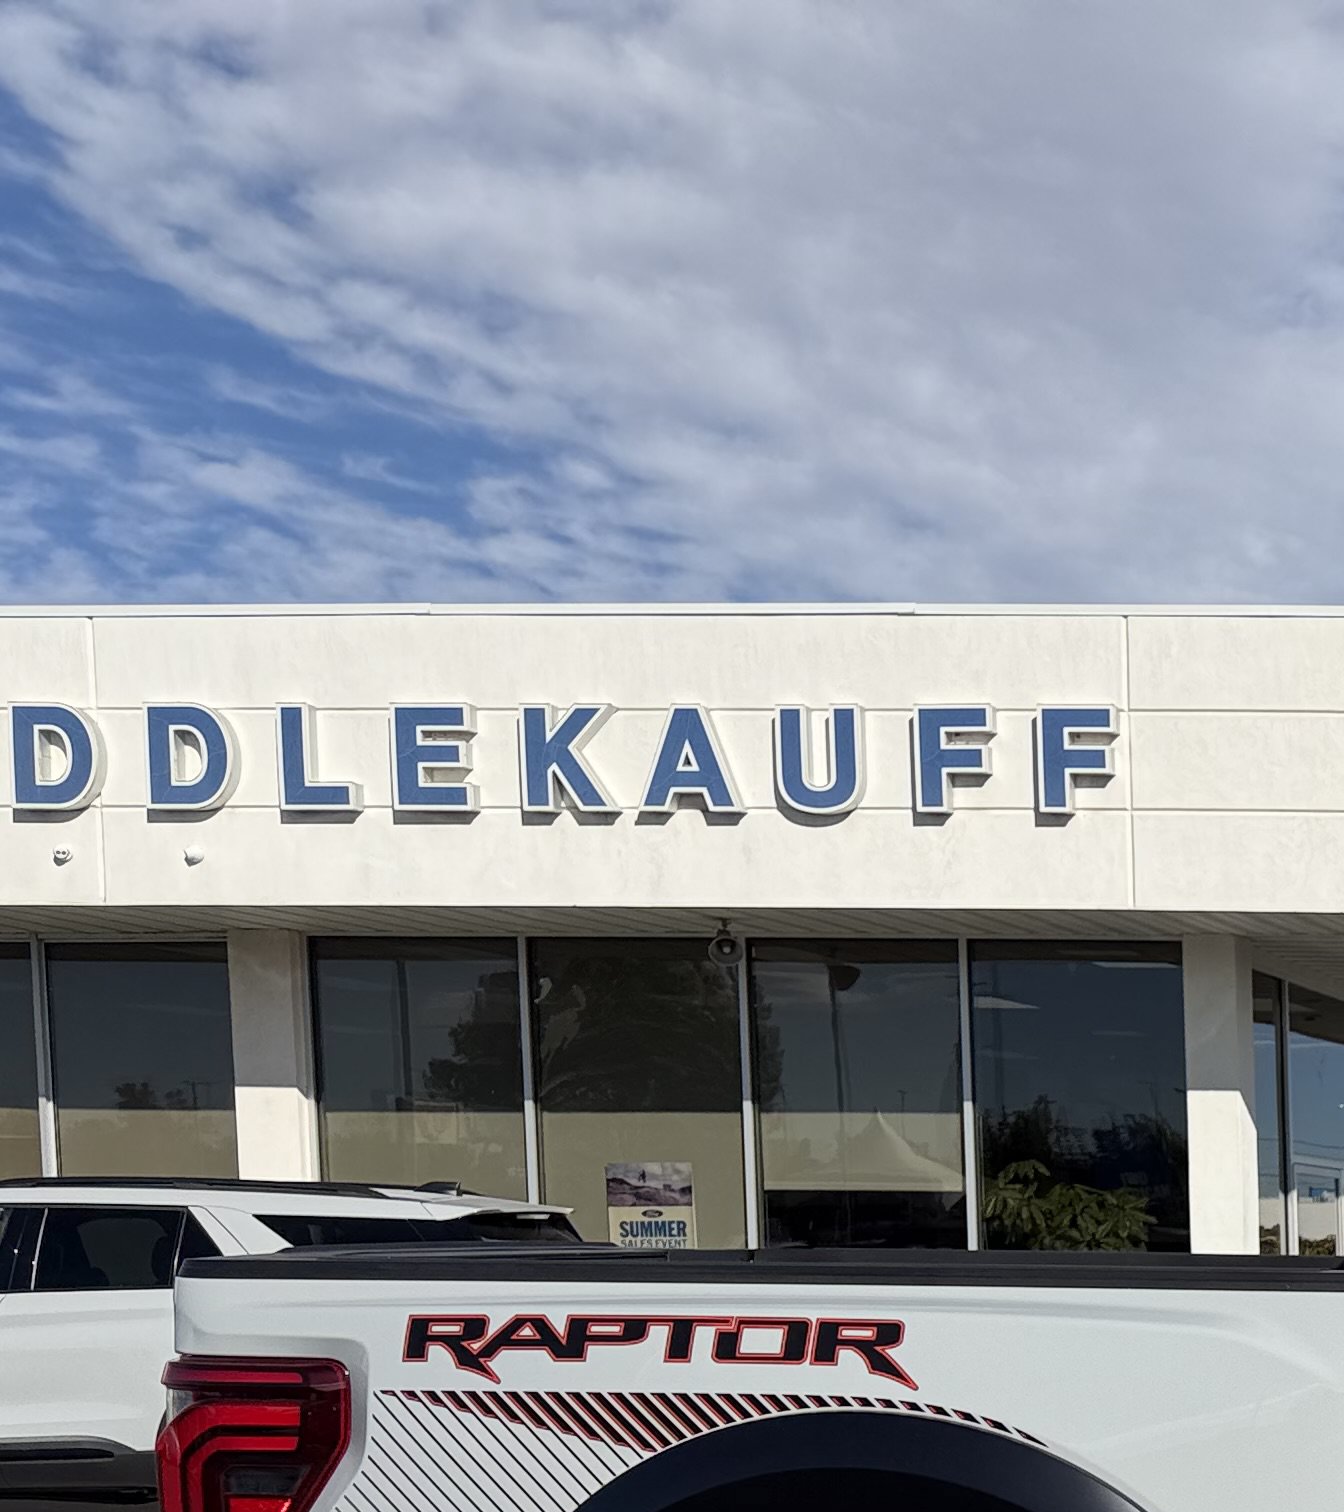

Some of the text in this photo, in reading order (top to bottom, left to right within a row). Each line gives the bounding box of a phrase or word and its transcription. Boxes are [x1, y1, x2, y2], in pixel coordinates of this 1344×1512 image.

[8, 702, 1120, 816] DDLEKAUFF
[619, 1220, 688, 1238] SUMMER
[620, 1238, 688, 1249] SALES EVENT
[402, 1313, 919, 1392] RAPTOR
